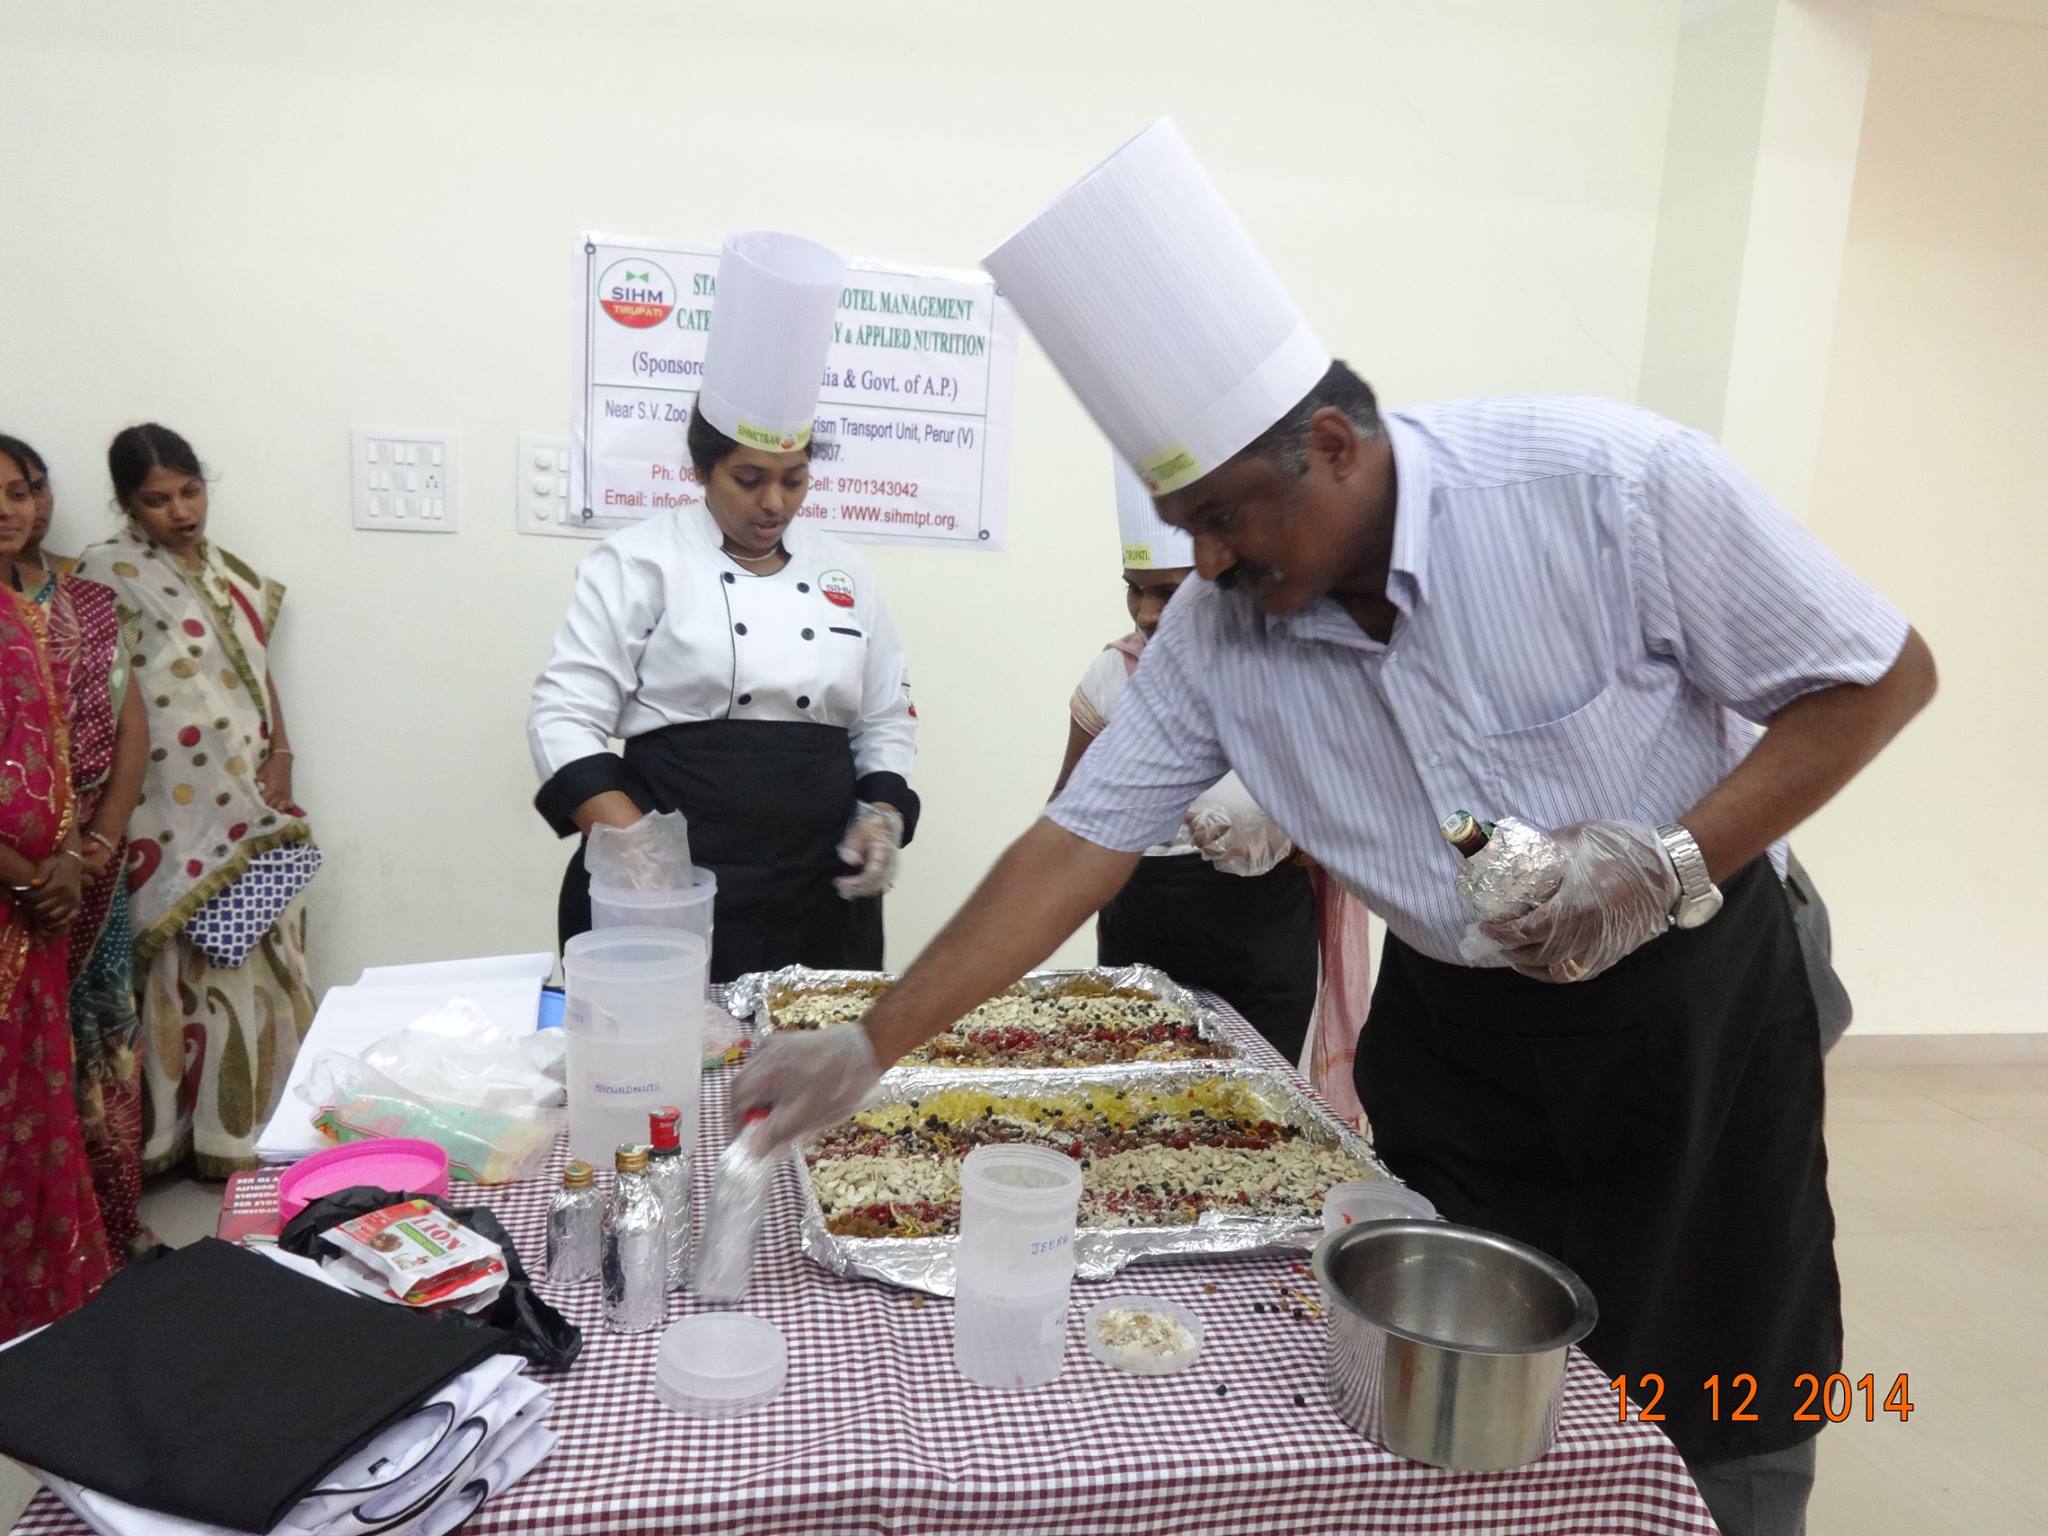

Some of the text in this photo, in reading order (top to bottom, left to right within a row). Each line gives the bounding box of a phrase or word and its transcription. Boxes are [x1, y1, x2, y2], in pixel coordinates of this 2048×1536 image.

[611, 286, 664, 304] SIHM
[693, 273, 718, 296] STA
[880, 292, 974, 321] MANAGEMENT
[677, 308, 711, 332] CATE
[845, 328, 852, 344] &
[856, 325, 911, 350] APPLIED
[915, 330, 985, 357] NUTRITION
[632, 350, 705, 378] (Sponsore
[843, 368, 856, 389] &
[861, 371, 900, 393] Govt.
[904, 375, 921, 395] of
[924, 376, 958, 402] A.P.)
[605, 399, 974, 449] Near S.V. Zoo rism Transport Unit, Perur (V)
[652, 464, 674, 481] Ph:
[838, 478, 918, 498] 9701343042
[604, 489, 647, 507] Email:
[840, 504, 958, 530] WWW.sihmtpt.org.
[411, 1218, 460, 1251] LION
